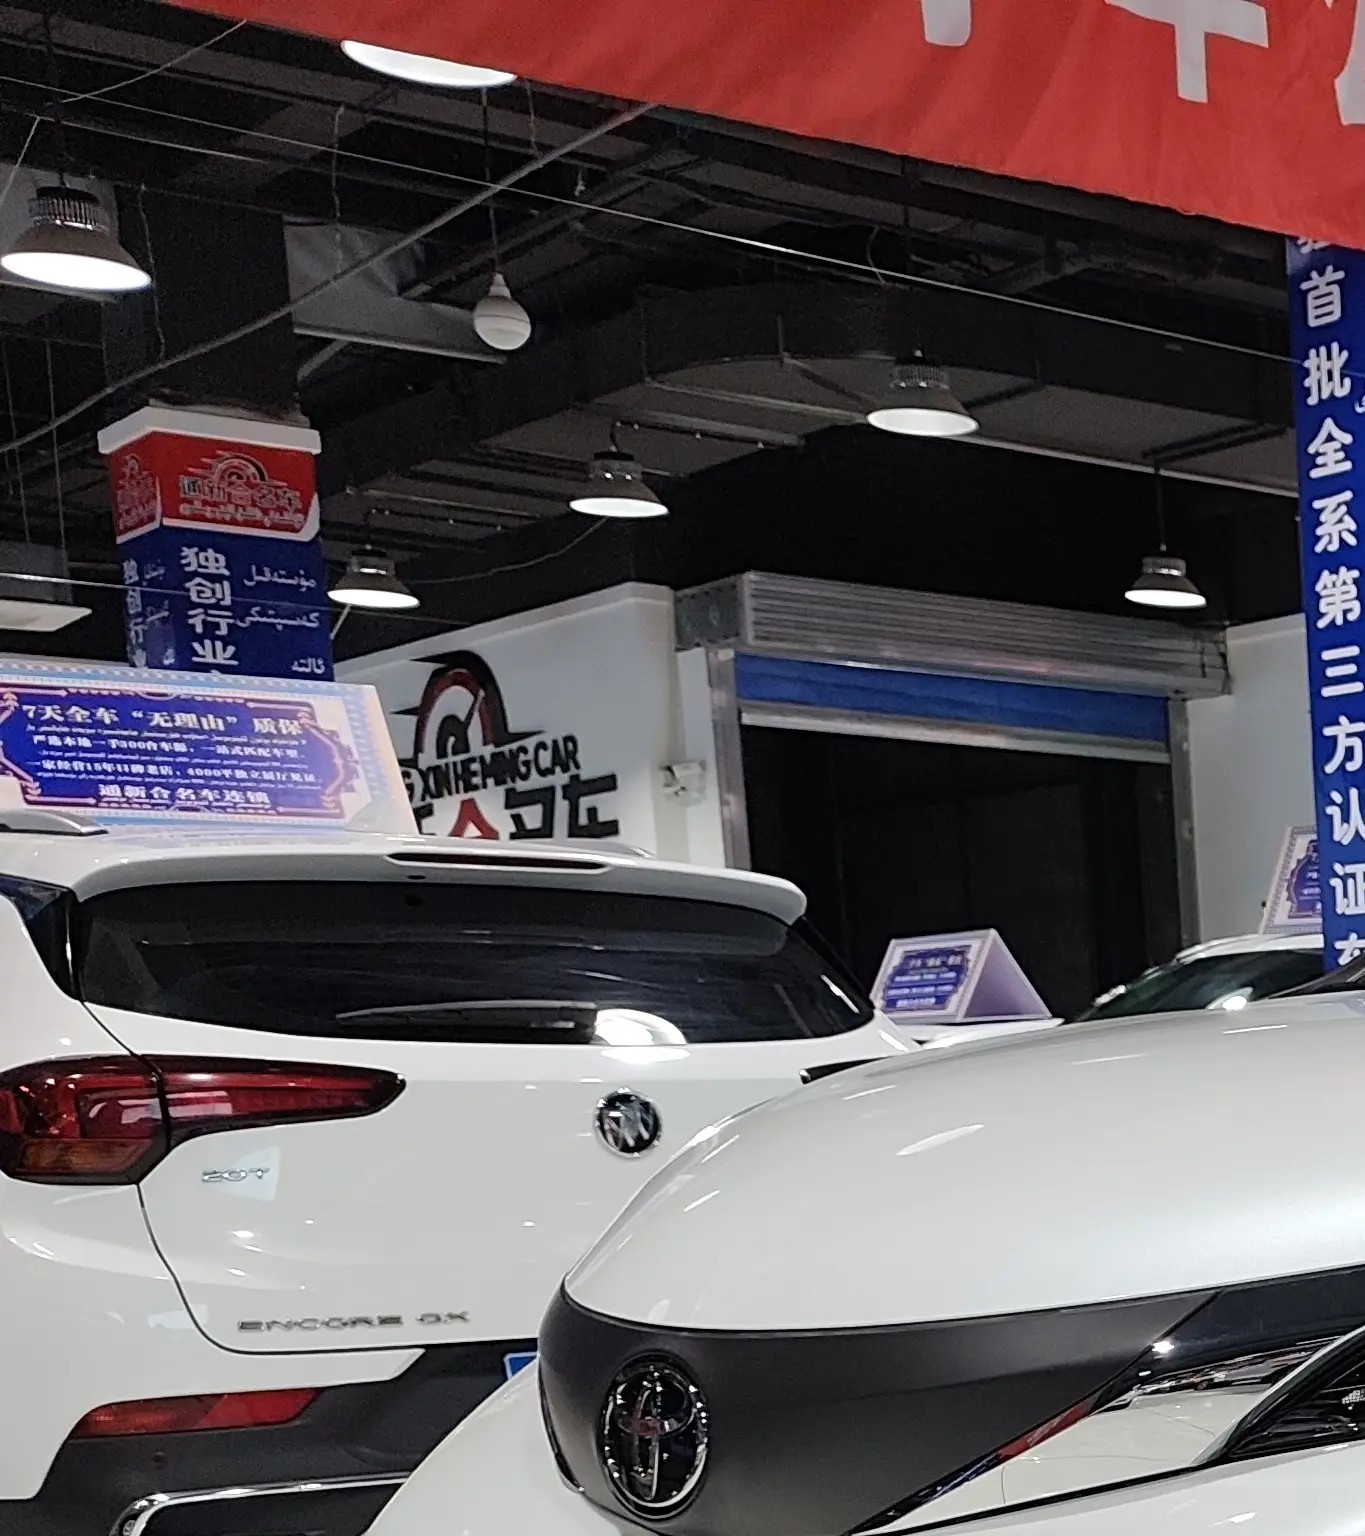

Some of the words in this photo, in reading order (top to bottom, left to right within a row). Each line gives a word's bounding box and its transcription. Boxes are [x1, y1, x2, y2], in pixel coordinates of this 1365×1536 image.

[180, 546, 239, 674] 独创行业
[534, 734, 581, 778] CAR
[238, 1313, 403, 1332] ENCORE
